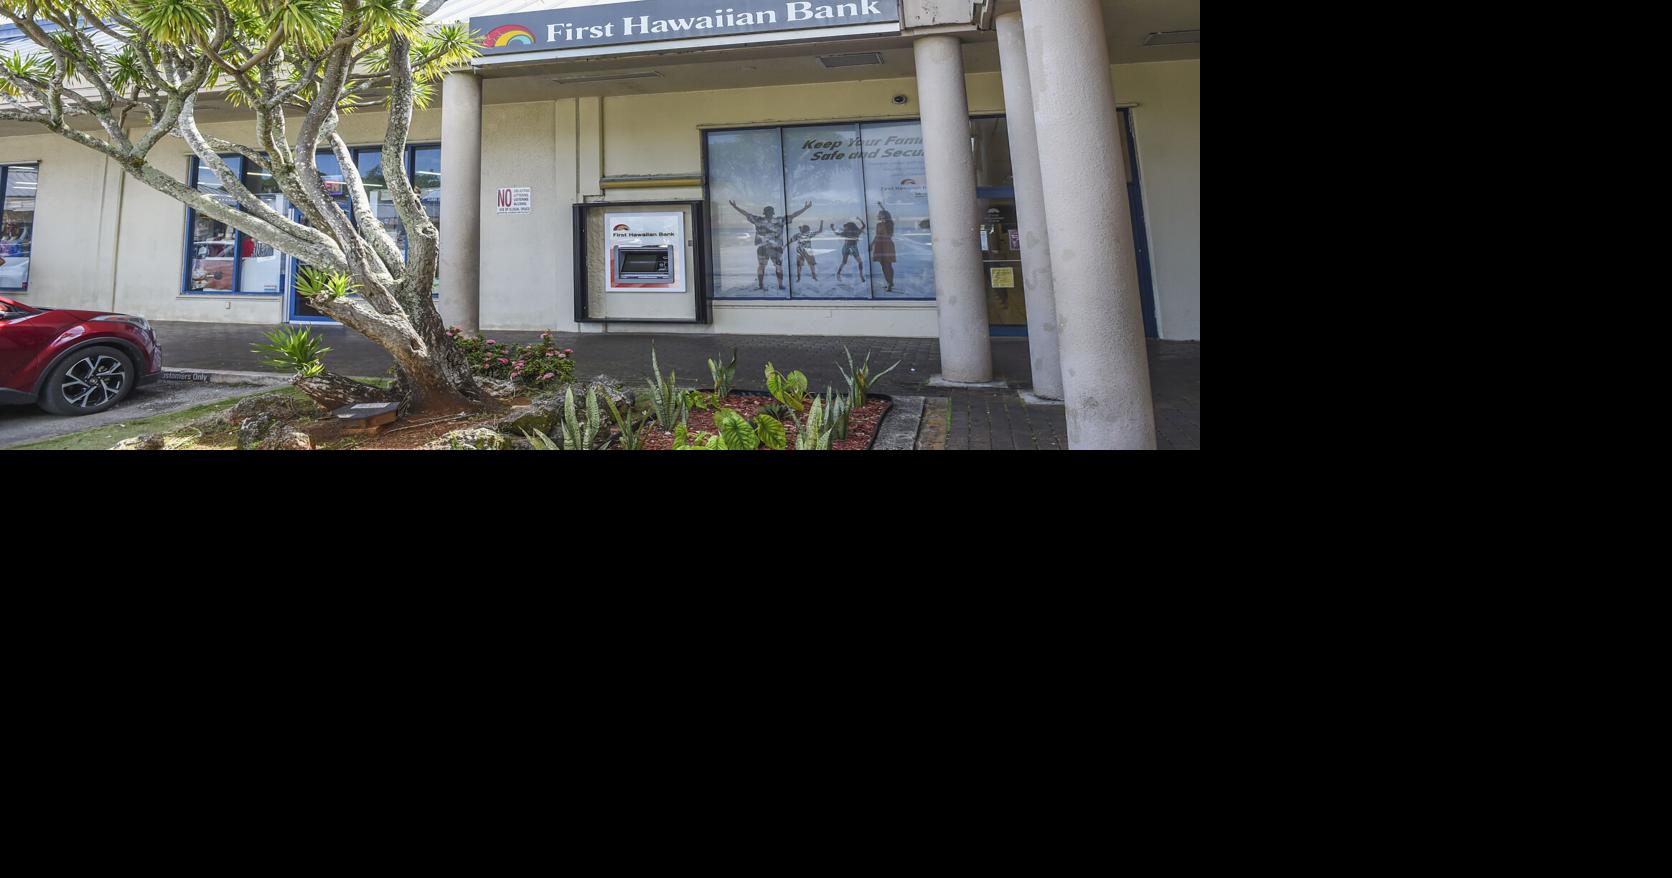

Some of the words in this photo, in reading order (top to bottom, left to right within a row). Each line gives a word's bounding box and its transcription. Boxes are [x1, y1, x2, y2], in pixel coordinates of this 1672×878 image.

[546, 22, 614, 43] First
[622, 8, 777, 36] Hawaiian
[786, 0, 881, 22] Bank
[802, 138, 843, 150] Keep
[848, 137, 882, 147] Your
[810, 150, 845, 161] Safe
[848, 148, 880, 159] and
[497, 188, 512, 207] NO
[192, 373, 208, 381] Only
